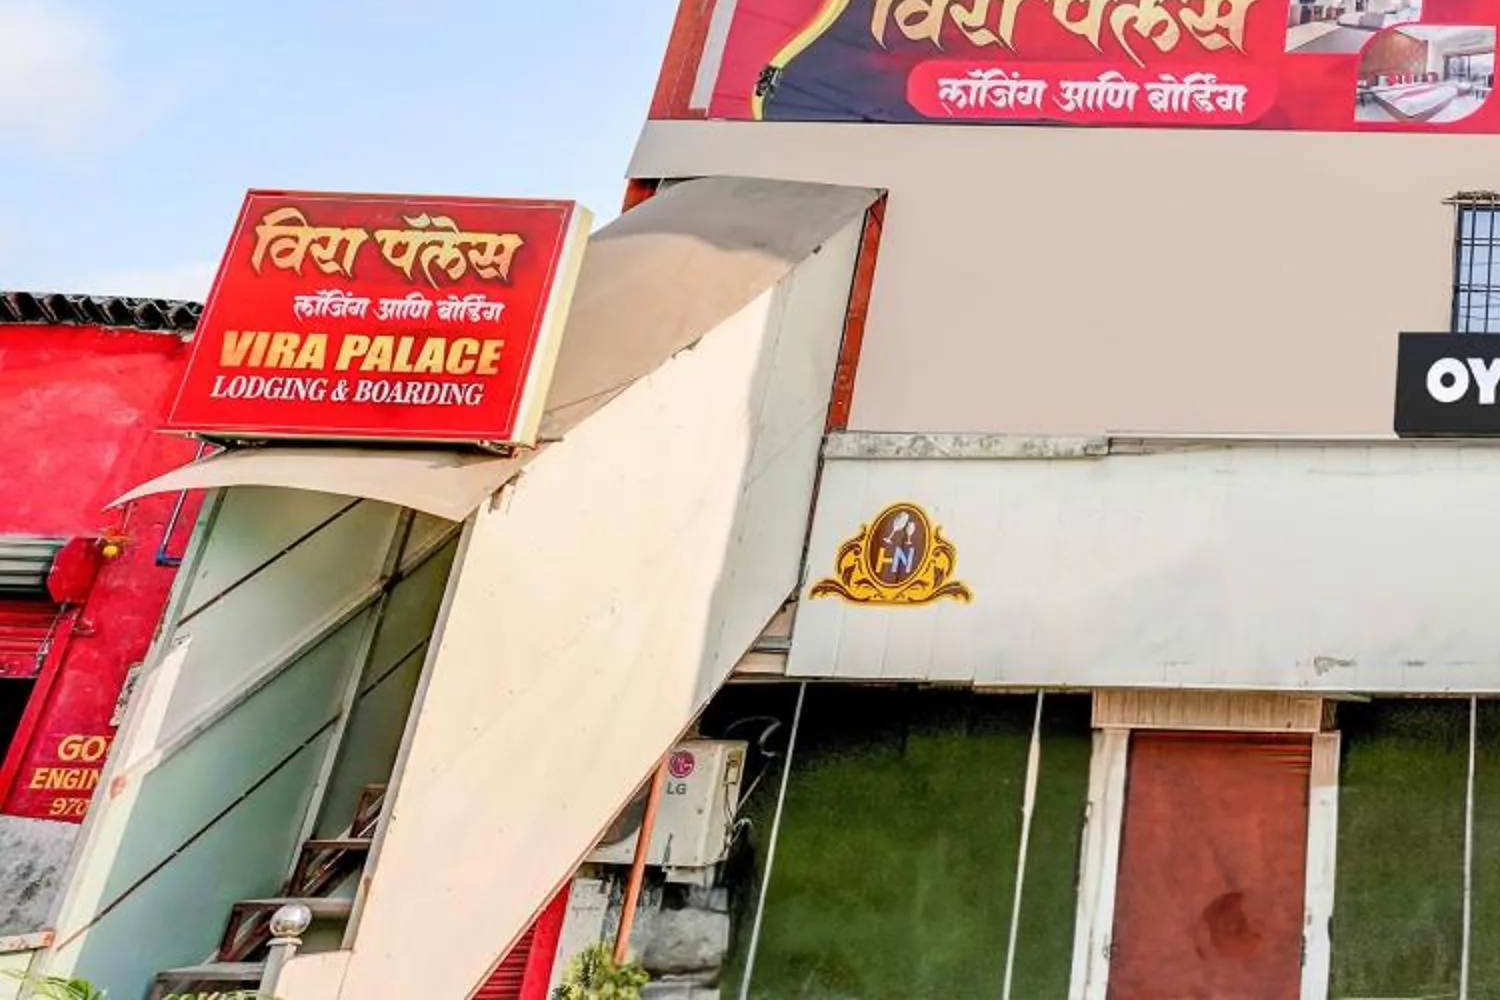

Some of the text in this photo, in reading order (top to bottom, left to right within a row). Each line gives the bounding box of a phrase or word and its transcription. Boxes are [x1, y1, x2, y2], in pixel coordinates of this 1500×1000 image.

[1053, 70, 1138, 113] आणि
[251, 206, 369, 277] विरा
[374, 292, 432, 321] आणि
[219, 330, 504, 375] VIRA PALACE
[210, 375, 485, 406] LODGING & BOARDING
[666, 782, 687, 795] LG
